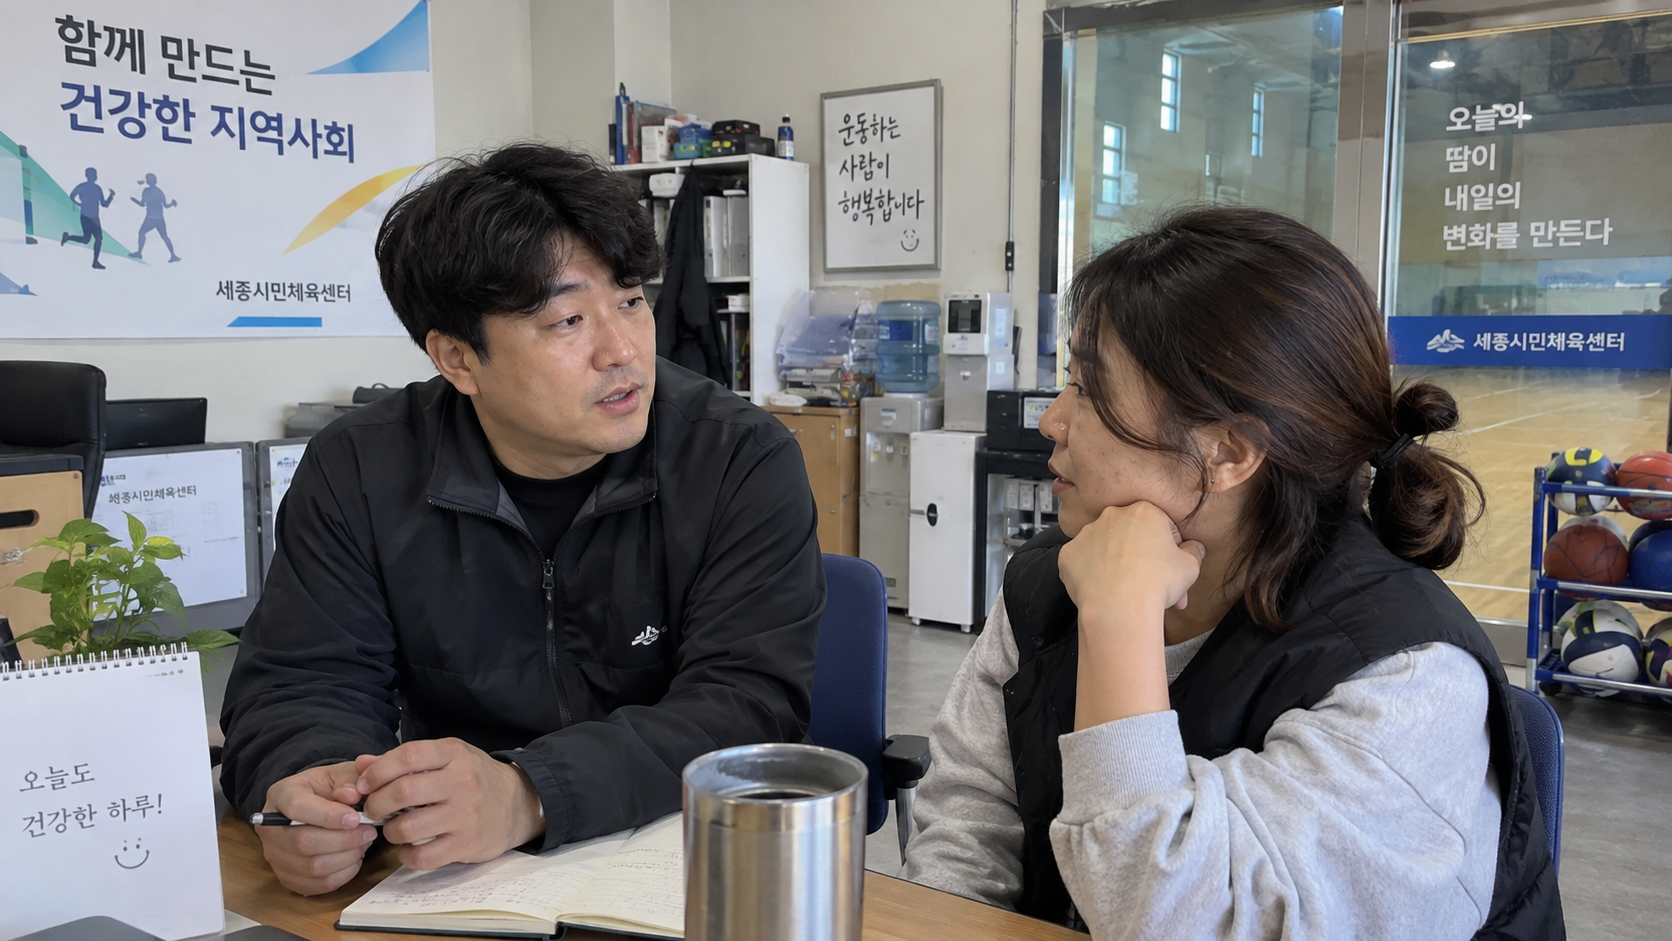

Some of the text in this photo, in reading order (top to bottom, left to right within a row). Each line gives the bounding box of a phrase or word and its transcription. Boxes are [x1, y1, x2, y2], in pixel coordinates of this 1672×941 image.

[55, 14, 276, 96] 함께 만드는
[60, 82, 355, 164] 건강한 지역사회
[838, 112, 900, 147] 운동하는
[1445, 101, 1523, 132] 오늘의
[838, 151, 889, 182] 사람이
[1445, 143, 1496, 173] 땀이
[838, 187, 925, 226] 행복합니다
[1444, 182, 1521, 212] 내일의
[1443, 217, 1614, 251] 변화를 만든다
[215, 280, 350, 303] 세종시민체육센터
[1473, 332, 1625, 353] 세종시민체육센터
[19, 763, 95, 792] 오늘도
[22, 793, 162, 838] 건강한 하루!
